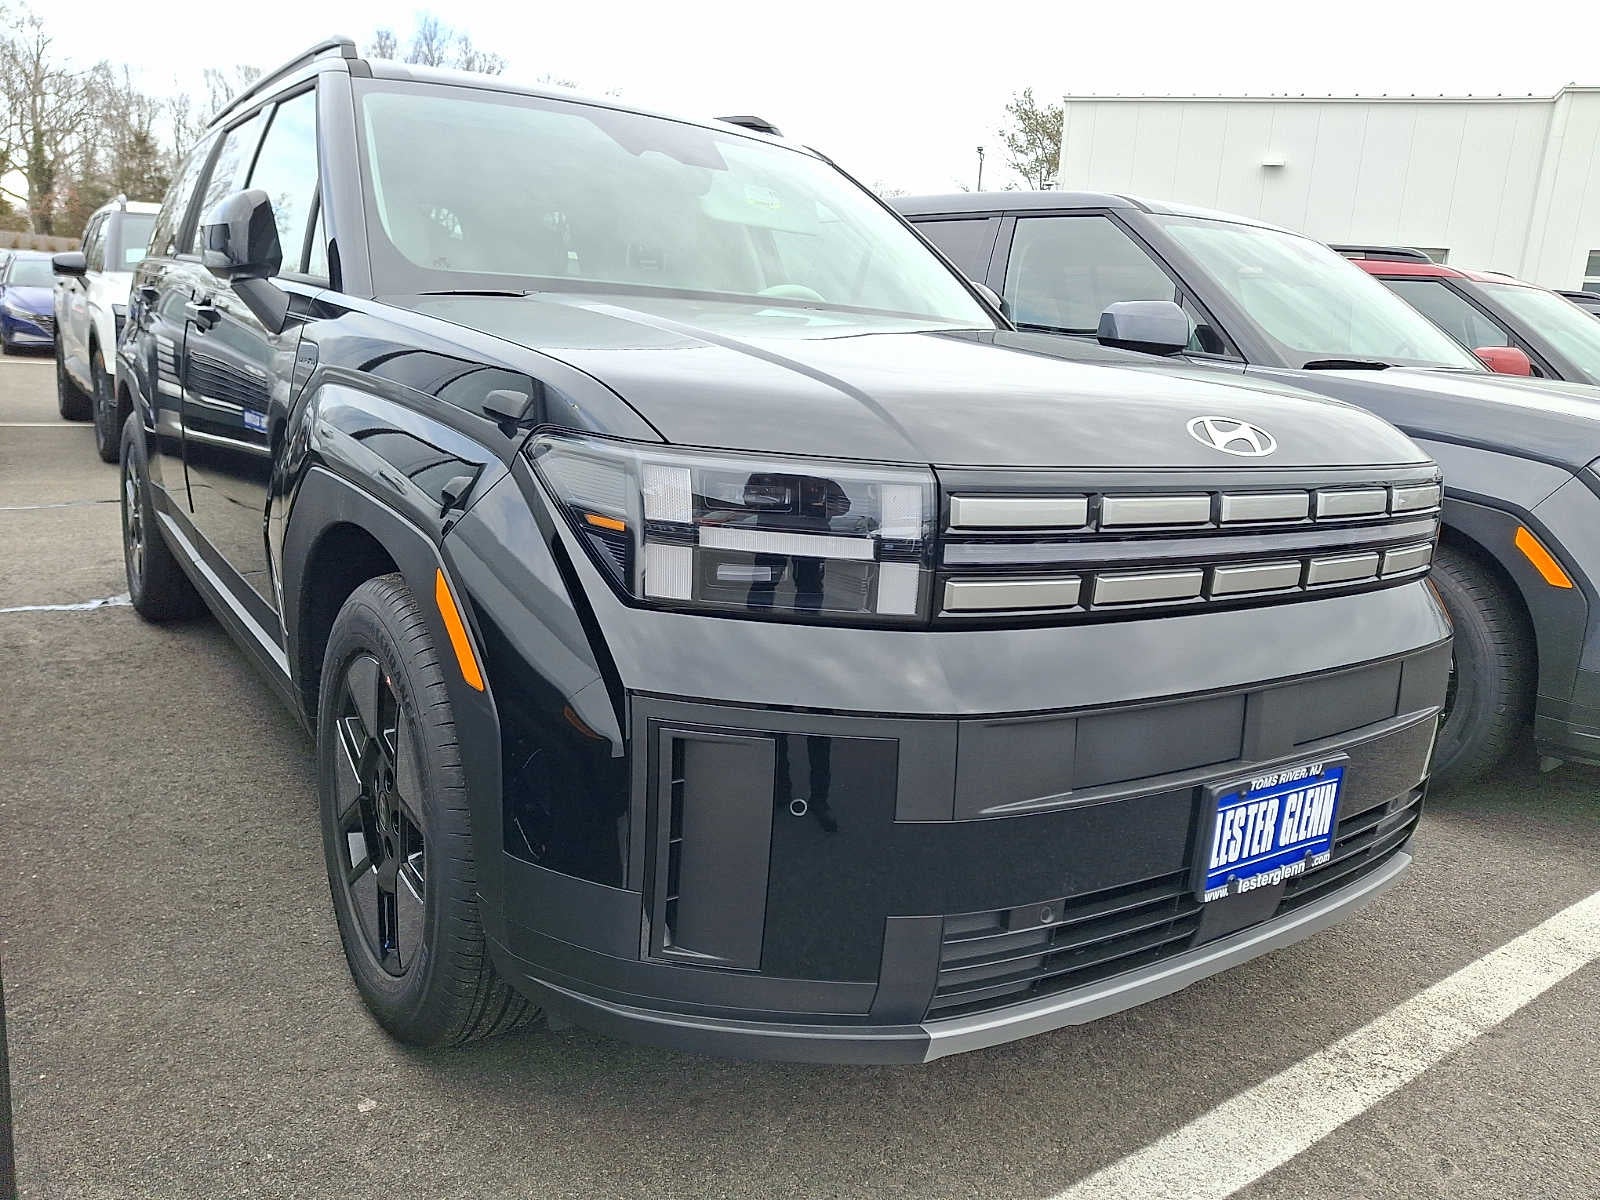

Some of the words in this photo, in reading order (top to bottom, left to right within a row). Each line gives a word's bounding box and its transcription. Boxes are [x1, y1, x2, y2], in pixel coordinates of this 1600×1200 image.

[1250, 774, 1279, 792] TOMS
[1309, 764, 1323, 778] NJ
[1209, 798, 1280, 870] LESTER
[1279, 782, 1338, 847] GLENN
[1237, 863, 1306, 894] lesterglenn
